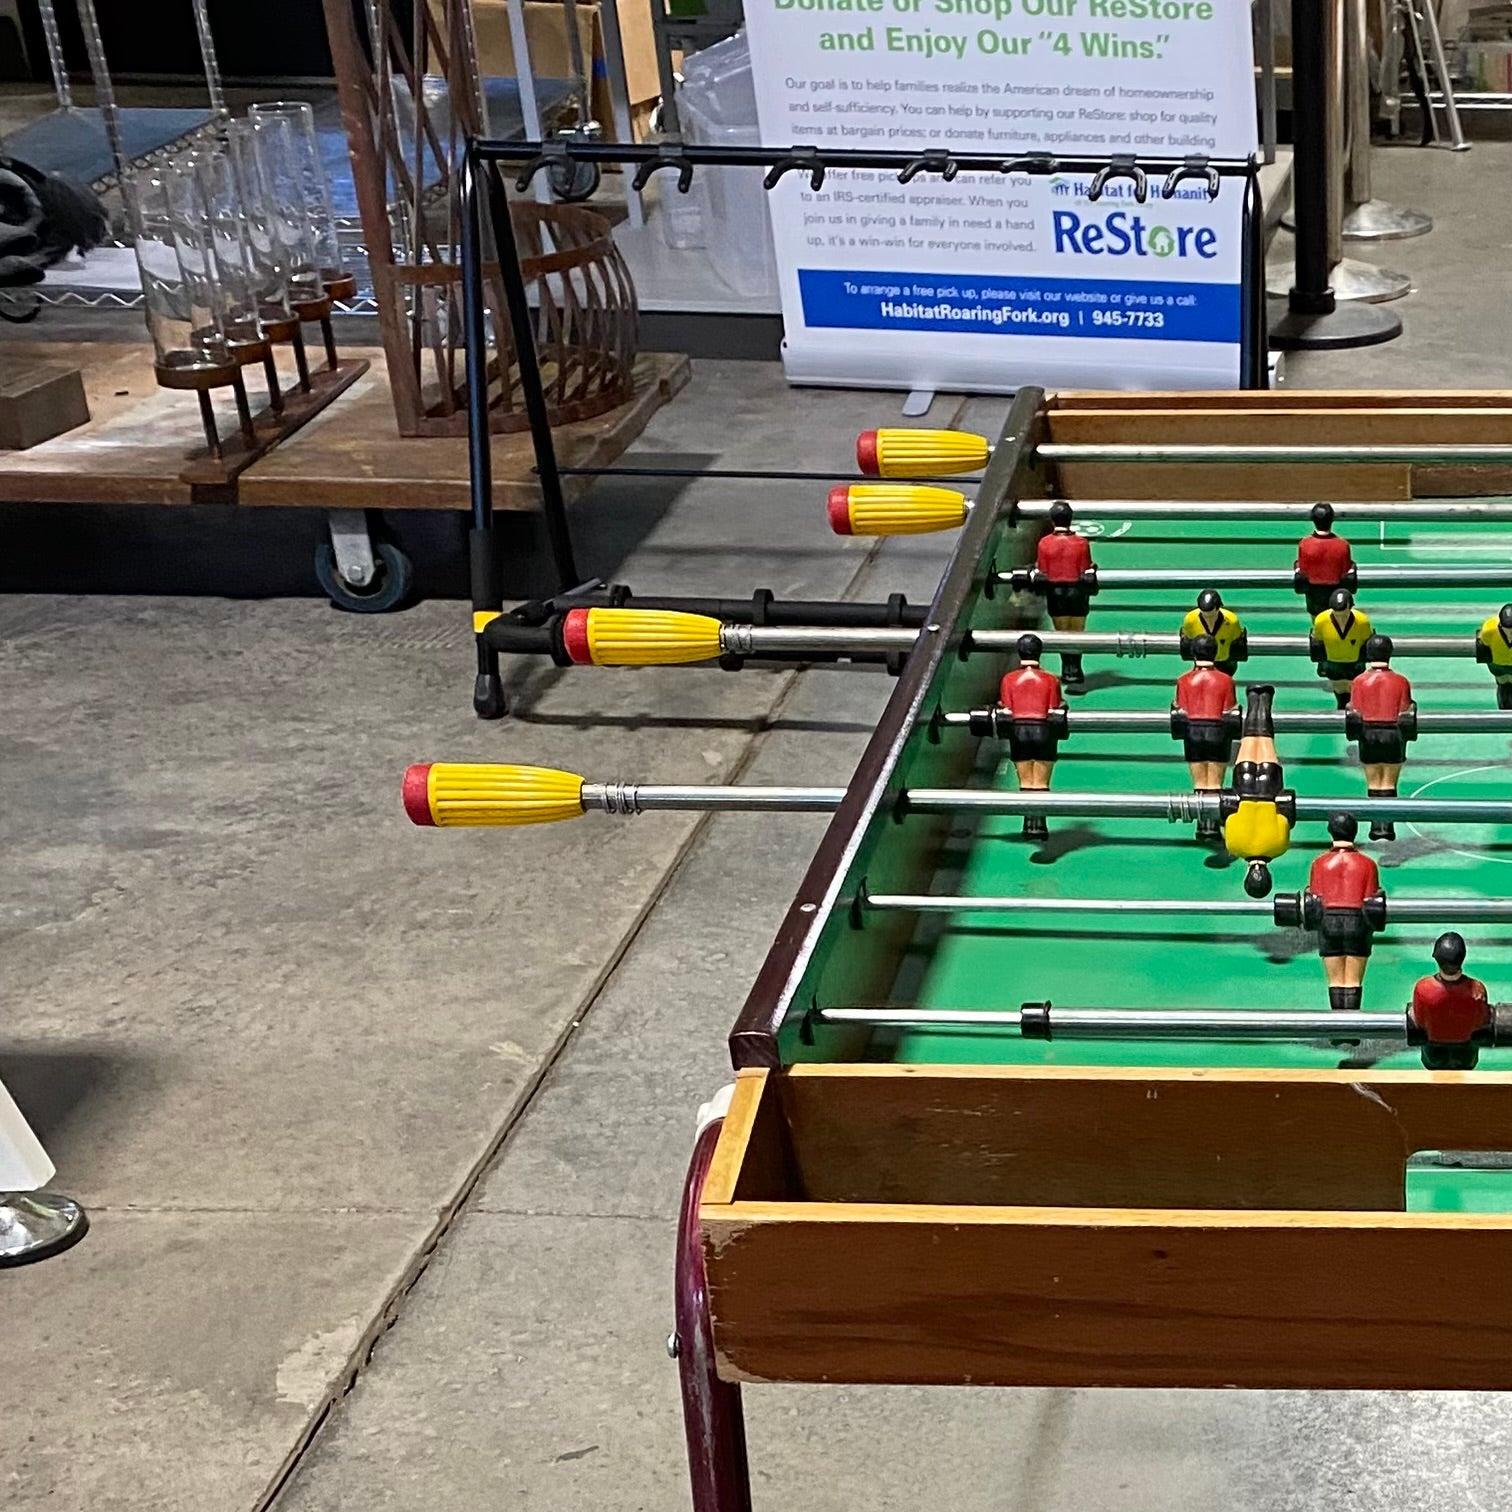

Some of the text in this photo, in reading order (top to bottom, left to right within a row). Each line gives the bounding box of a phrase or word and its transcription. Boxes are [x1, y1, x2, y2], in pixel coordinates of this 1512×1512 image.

[893, 0, 920, 12] or
[935, 0, 1012, 20] Shop
[1022, 0, 1077, 16] Our
[1090, 0, 1213, 20] ReStore
[819, 27, 874, 51] and
[886, 27, 967, 59] Enjoy
[977, 29, 1032, 54] Our
[785, 77, 1214, 101] Our goal is to help families realize the American dream of homeownership
[789, 101, 809, 112] and
[901, 104, 922, 114] You
[925, 106, 945, 115] can
[948, 104, 973, 118] help
[975, 106, 989, 119] by
[992, 107, 1053, 121] supporting
[1056, 110, 1075, 119] our
[1129, 109, 1158, 124] shop
[1160, 110, 1176, 122] for
[1179, 112, 1217, 126] quality
[792, 123, 823, 135] items
[826, 126, 838, 136] at
[841, 124, 885, 138] bargain
[929, 128, 942, 138] or
[945, 127, 985, 140] donate
[1044, 131, 1106, 144] appliances
[1109, 132, 1131, 144] and
[1134, 133, 1165, 145] other
[1168, 133, 1216, 149] building
[824, 168, 848, 180] ffer
[851, 169, 874, 181] free
[929, 174, 944, 183] an
[956, 174, 975, 184] can
[979, 173, 1006, 184] refer
[1011, 177, 1032, 187] you
[801, 191, 812, 202] to
[816, 193, 830, 202] an
[968, 195, 1003, 207] When
[1007, 199, 1028, 209] you
[1074, 182, 1124, 198] Hatat
[803, 212, 1035, 231] join us in giving a family in need a hand
[849, 238, 856, 247] a
[859, 237, 905, 248] win-win
[908, 237, 924, 249] for
[927, 240, 981, 253] everyone
[1052, 210, 1218, 259] ReStore
[844, 281, 858, 294] To
[860, 284, 900, 298] arrange
[902, 286, 910, 296] a
[912, 285, 934, 297] free
[936, 286, 959, 299] pick
[981, 289, 1017, 300] please
[1018, 289, 1041, 300] visit
[1043, 292, 1061, 301] our
[1064, 291, 1107, 303] website
[1110, 294, 1122, 303] or
[1124, 293, 1147, 306] give
[1150, 295, 1163, 305] us
[1166, 295, 1173, 306] a
[881, 301, 1069, 327] HabitatRoaringFork.org
[1092, 310, 1165, 327] 945-7733
